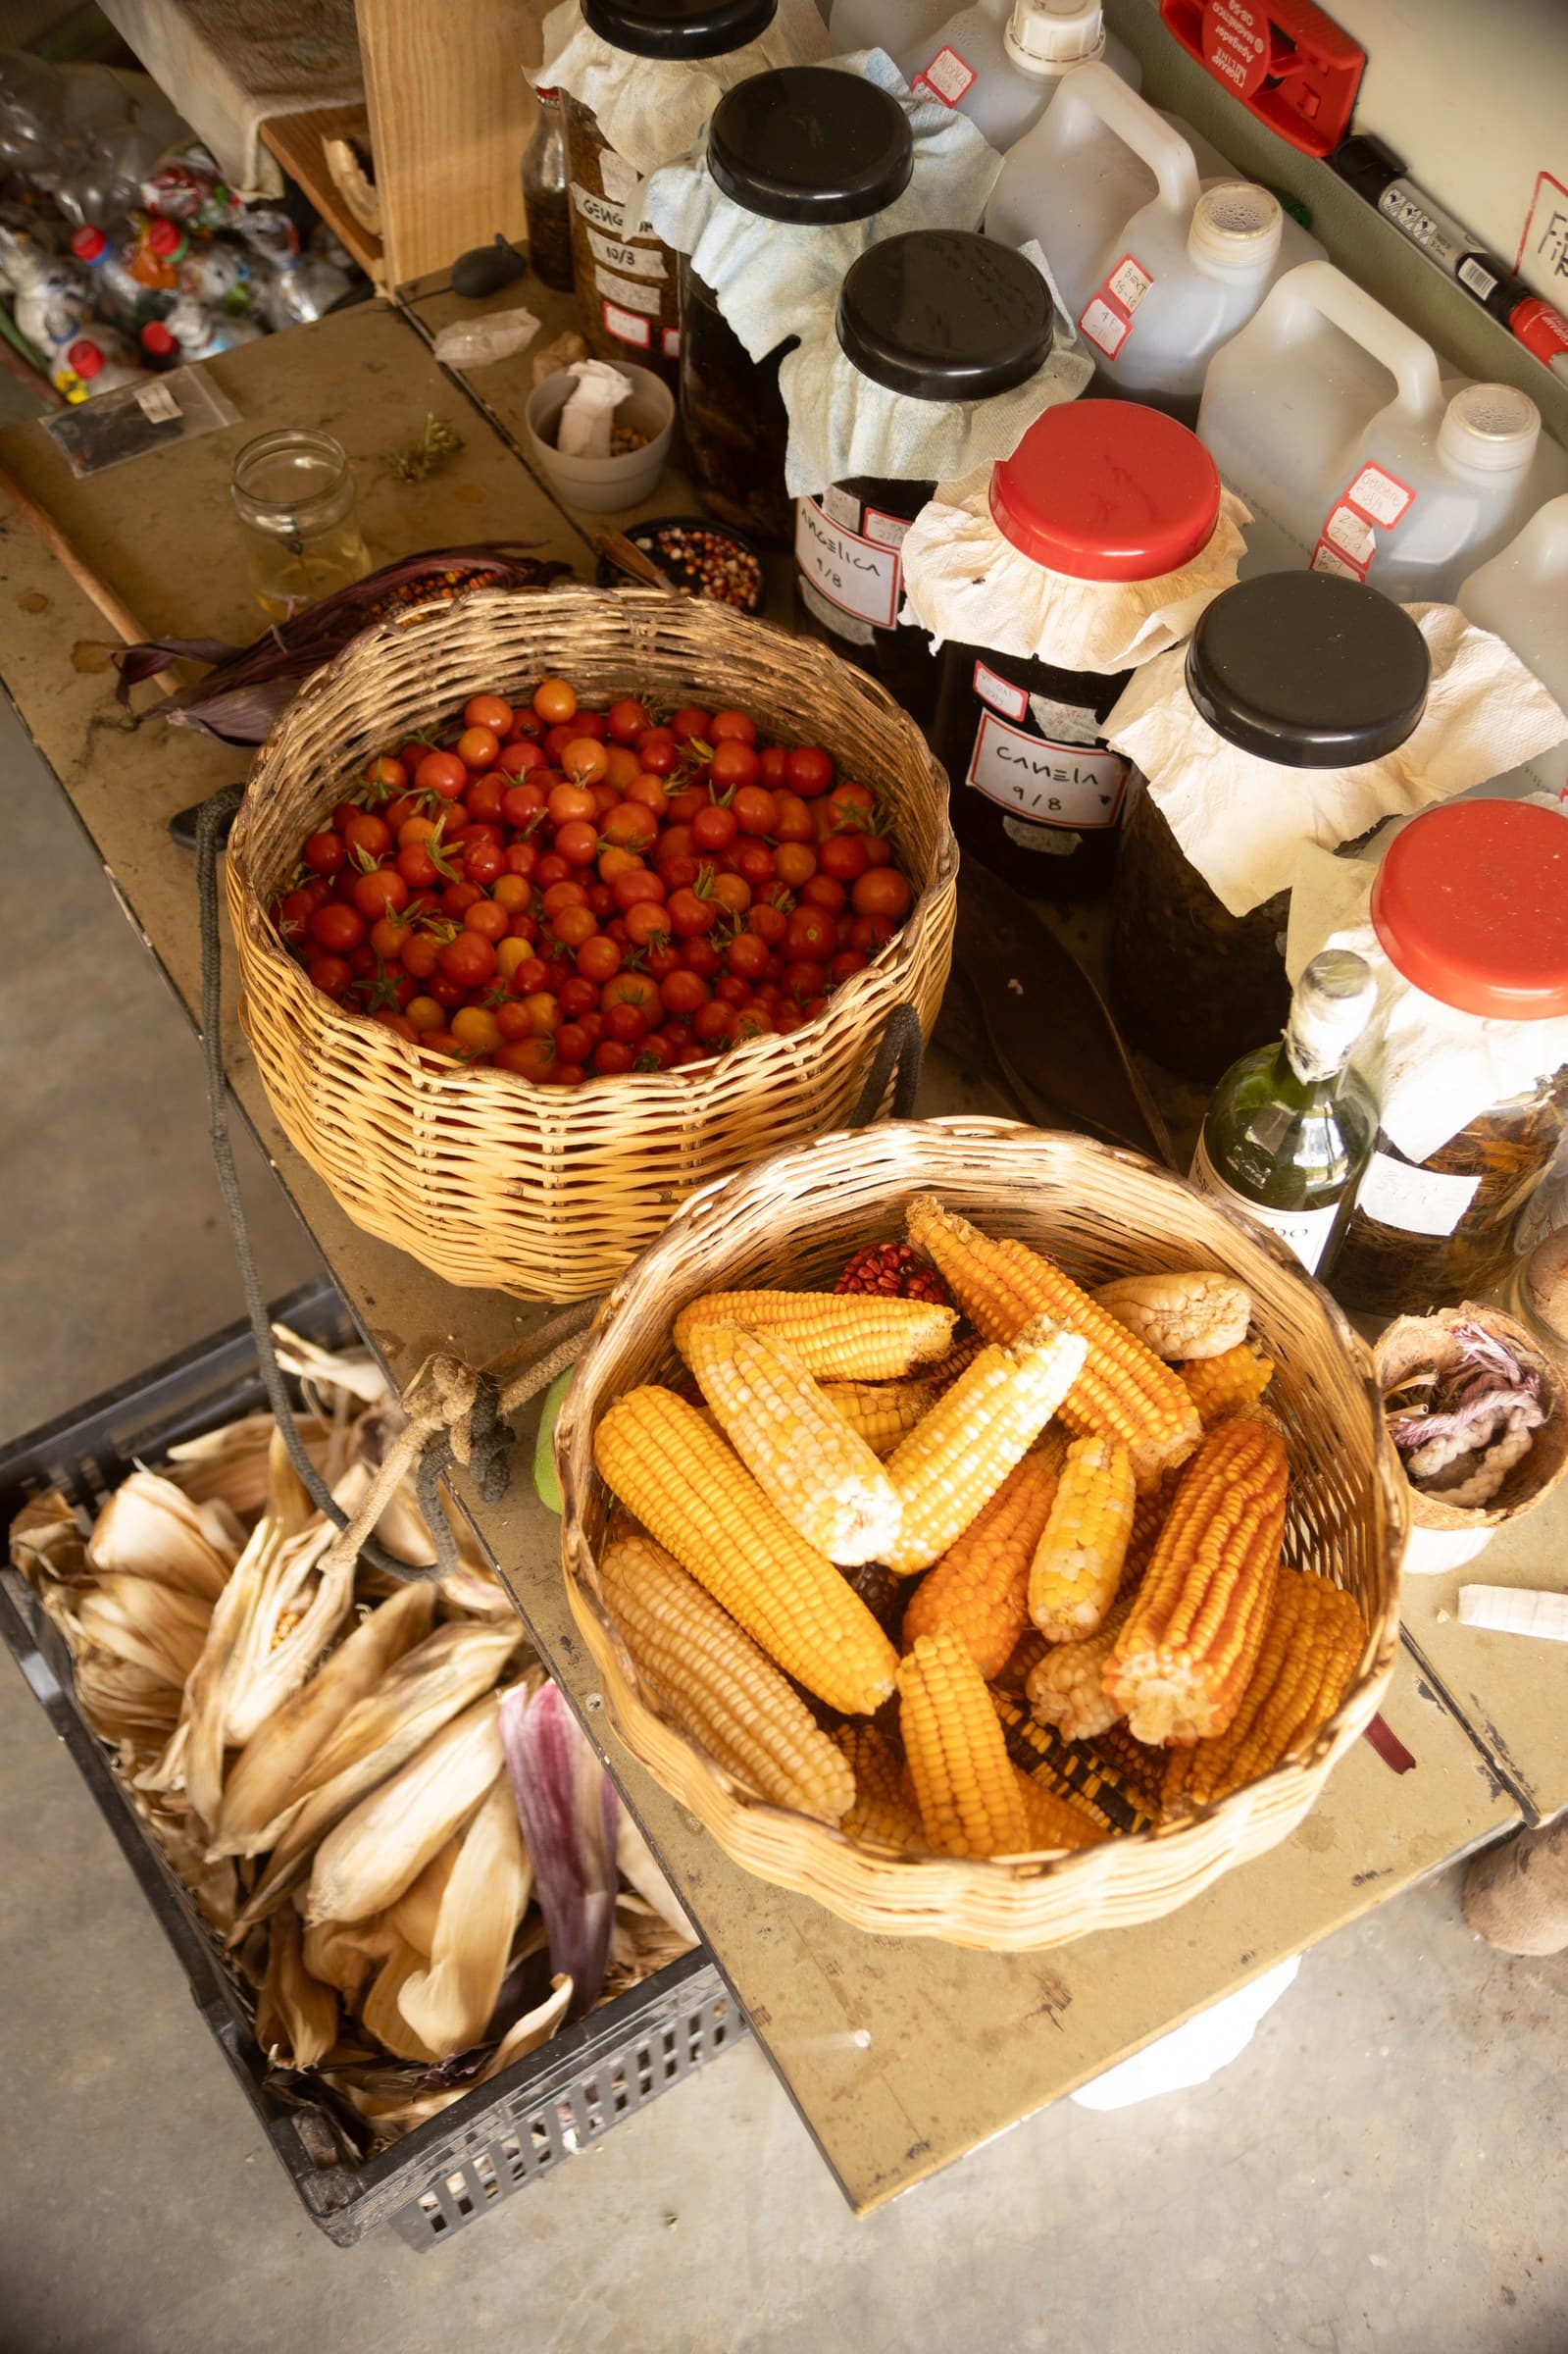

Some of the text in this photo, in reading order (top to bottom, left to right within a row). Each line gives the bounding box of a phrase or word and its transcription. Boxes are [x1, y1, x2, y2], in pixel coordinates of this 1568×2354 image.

[1215, 25, 1254, 63] Apagador
[801, 508, 881, 578] ANGELICA
[995, 745, 1099, 785] CANELA
[1012, 786, 1063, 812] 9/8
